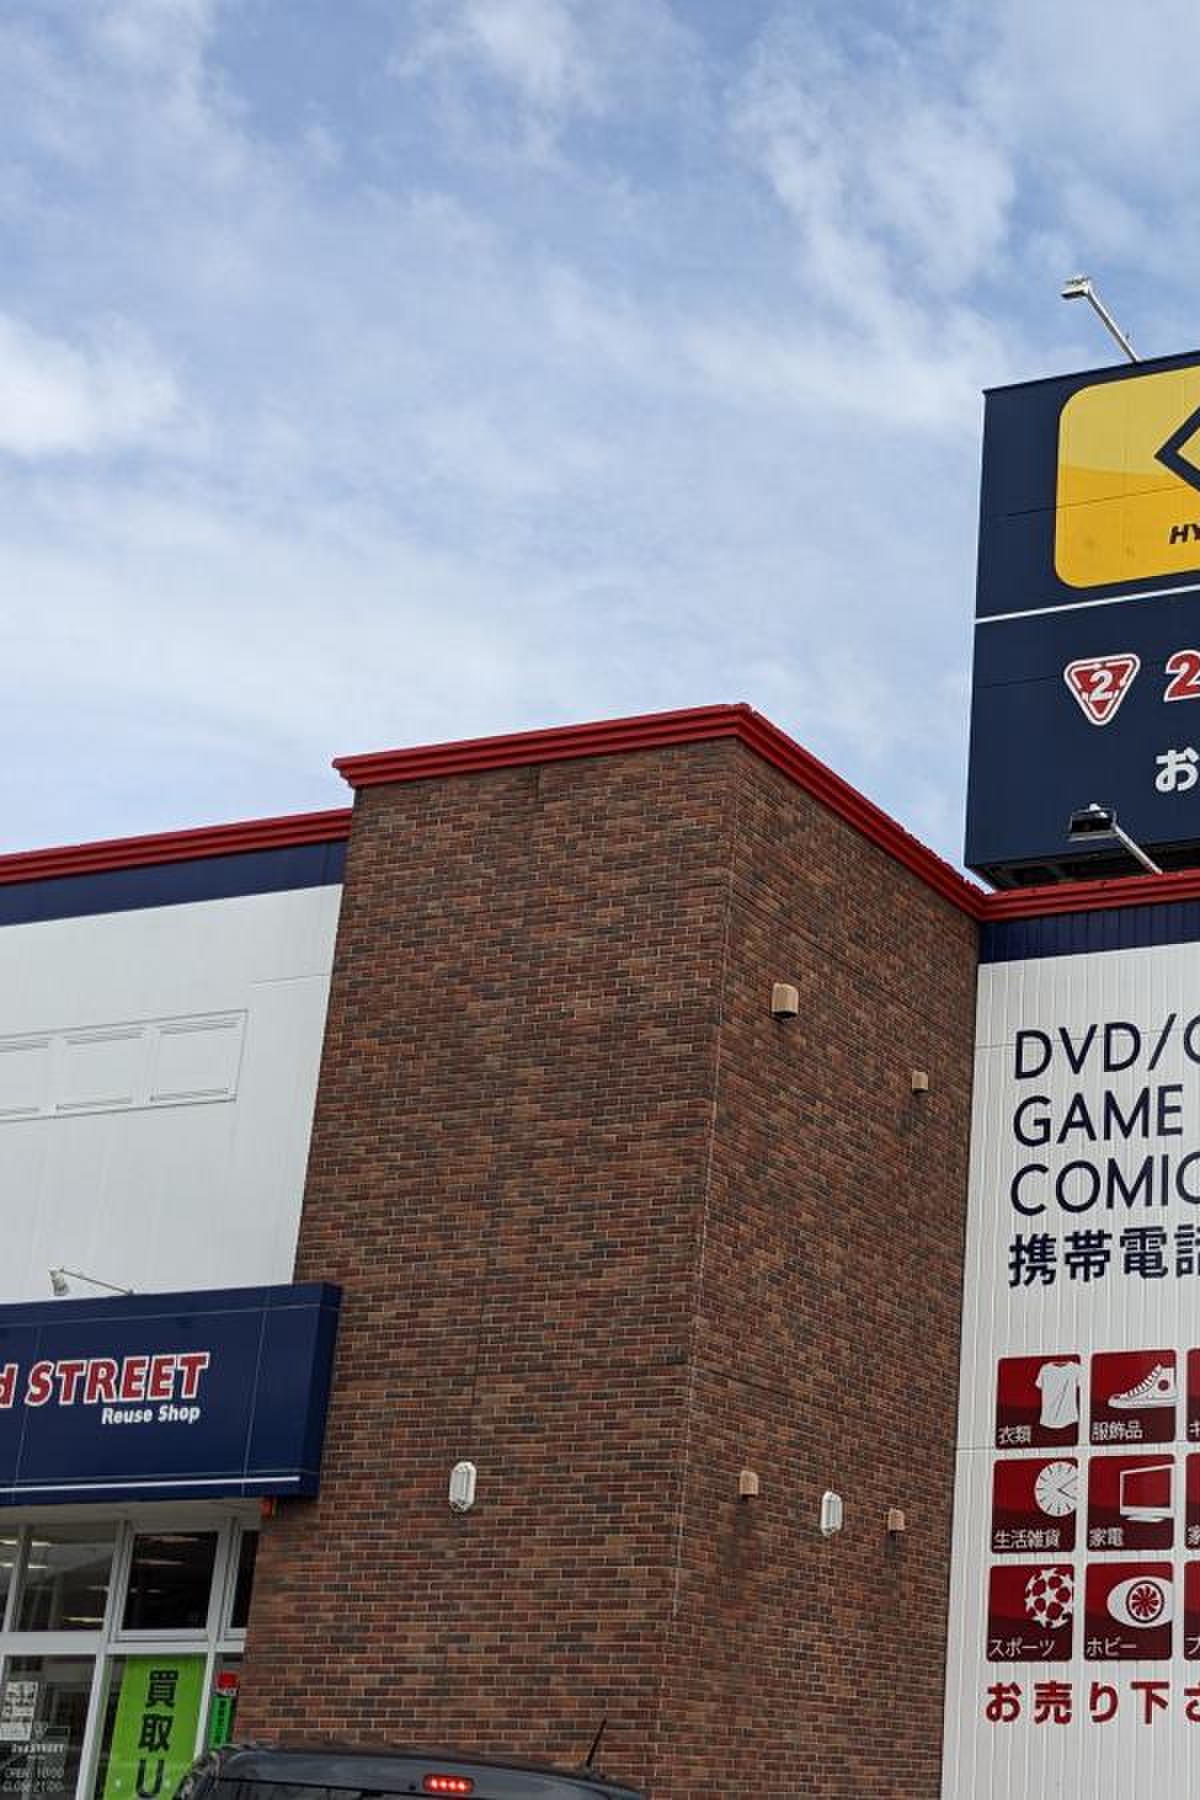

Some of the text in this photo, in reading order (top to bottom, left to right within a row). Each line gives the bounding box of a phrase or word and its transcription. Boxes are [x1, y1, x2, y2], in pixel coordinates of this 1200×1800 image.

[1013, 1084, 1184, 1147] GAME
[24, 1352, 210, 1407] STREET
[101, 1404, 201, 1425] Reuse Shop
[997, 1425, 1032, 1443] 衣類
[1091, 1421, 1143, 1441] 服飾品
[993, 1528, 1061, 1548] 生活雑貨
[1089, 1527, 1124, 1547] 家電
[989, 1637, 1056, 1657] スポーツ
[1086, 1637, 1137, 1656] ホビー
